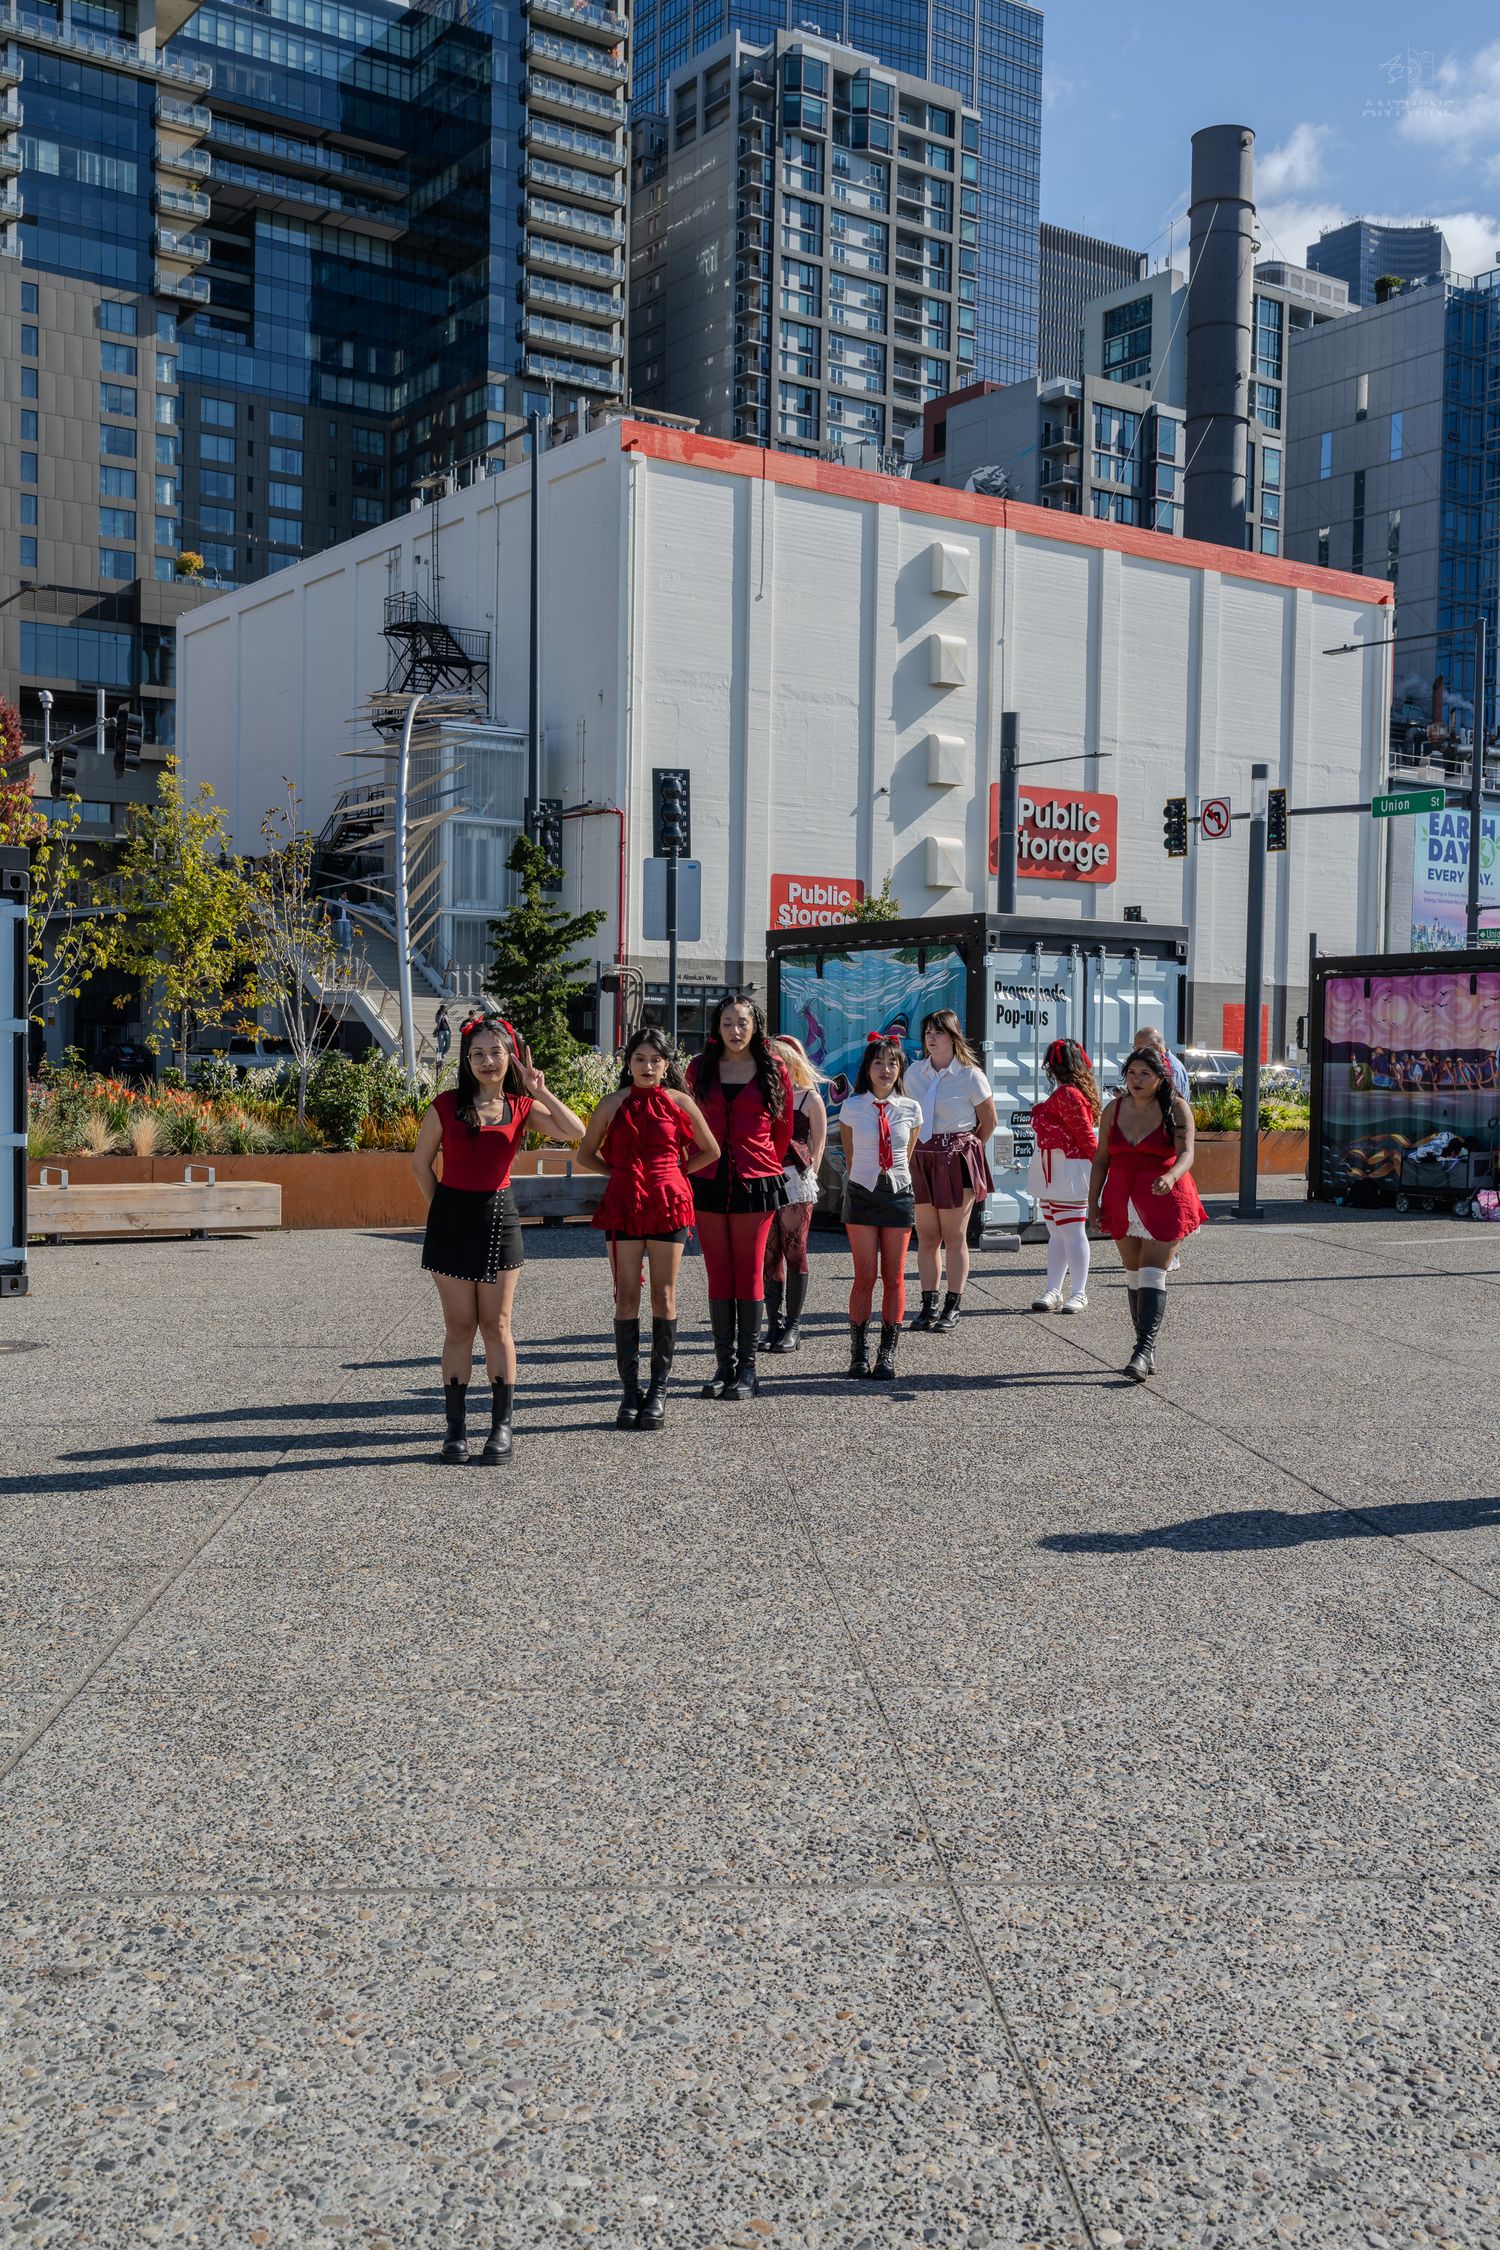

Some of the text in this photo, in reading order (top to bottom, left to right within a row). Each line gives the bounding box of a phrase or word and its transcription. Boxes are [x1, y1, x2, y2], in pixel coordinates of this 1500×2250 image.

[1381, 797, 1440, 812] Union St
[1018, 797, 1101, 833] Public
[1429, 813, 1495, 842] EARH
[1015, 830, 1110, 872] torage
[1428, 838, 1470, 865] DAY
[1428, 868, 1464, 883] EVERY
[788, 882, 851, 907] Public
[1486, 929, 1500, 938] Unio
[1012, 1113, 1031, 1123] Frien
[1014, 1130, 1034, 1138] Wate
[1015, 1146, 1031, 1155] Park
